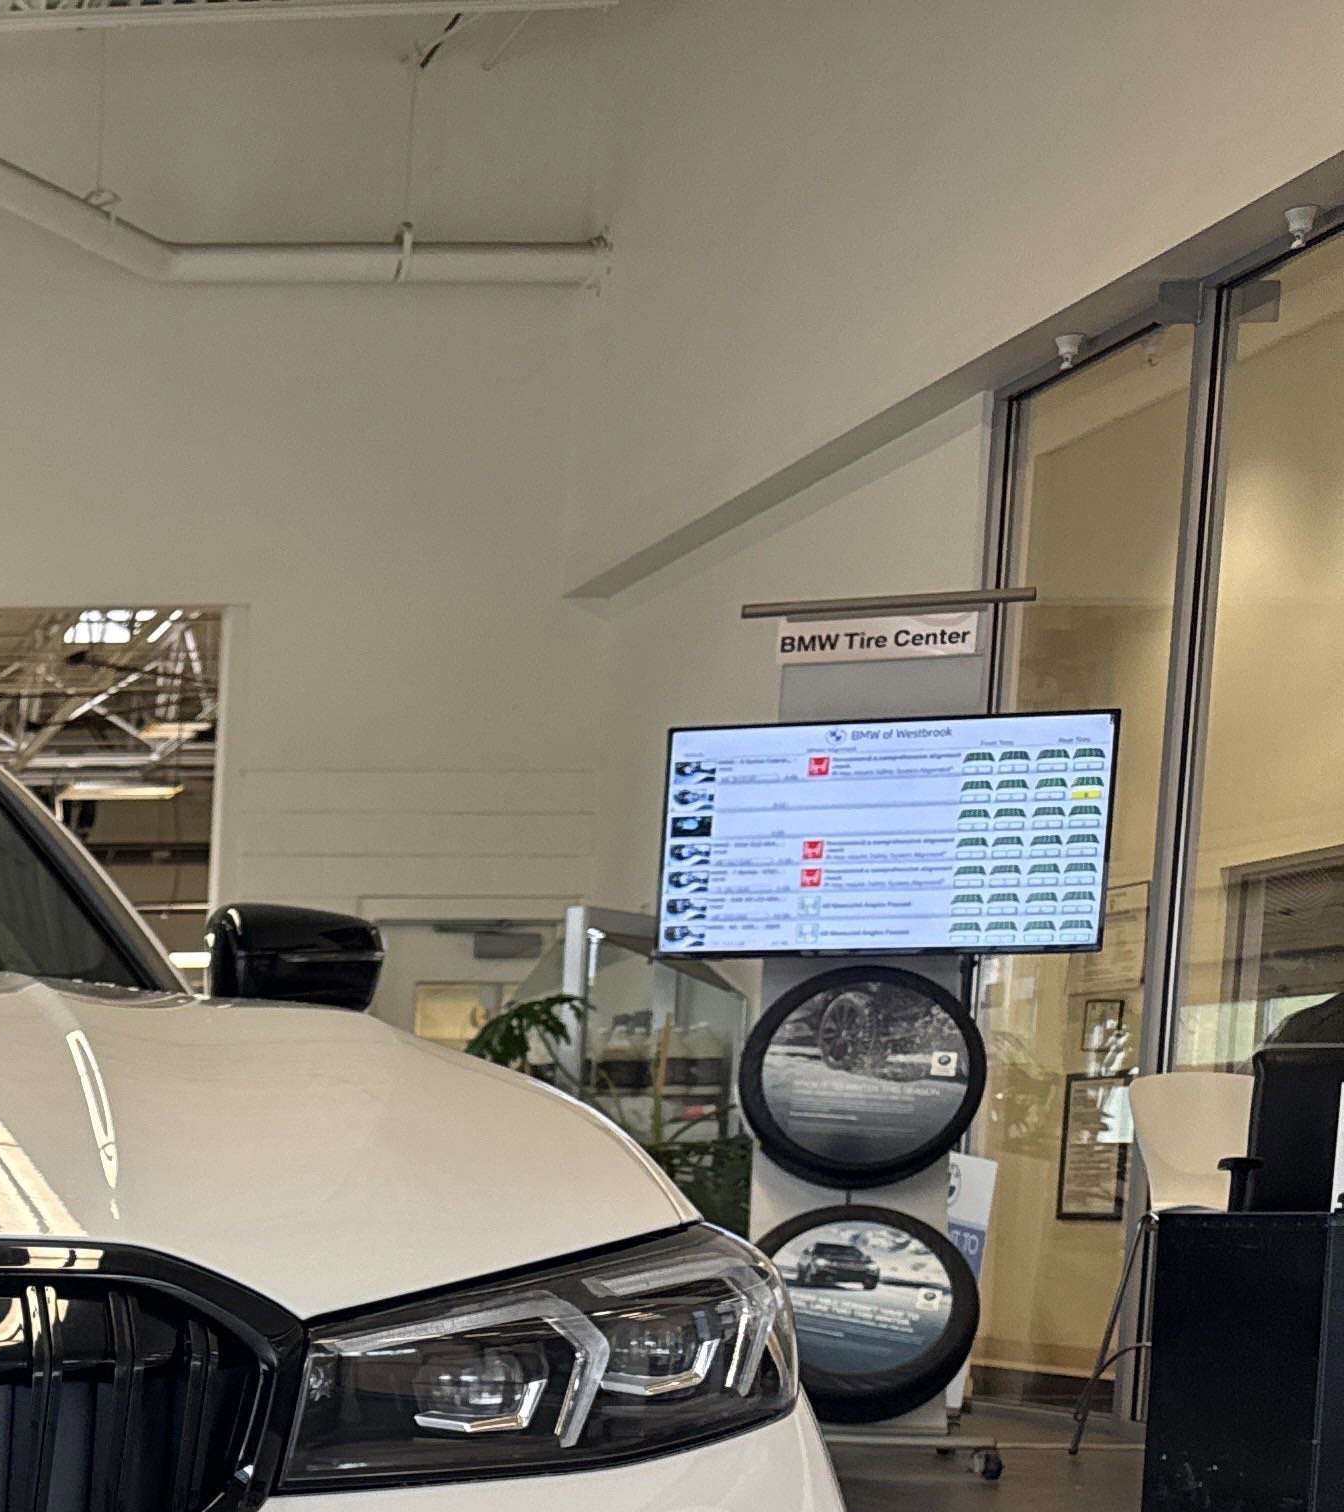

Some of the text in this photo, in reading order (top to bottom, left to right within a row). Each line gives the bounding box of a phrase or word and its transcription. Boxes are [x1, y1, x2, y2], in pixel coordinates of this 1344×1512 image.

[780, 628, 971, 653] BMW Tire Center
[851, 727, 952, 741] BMW of Westbrook
